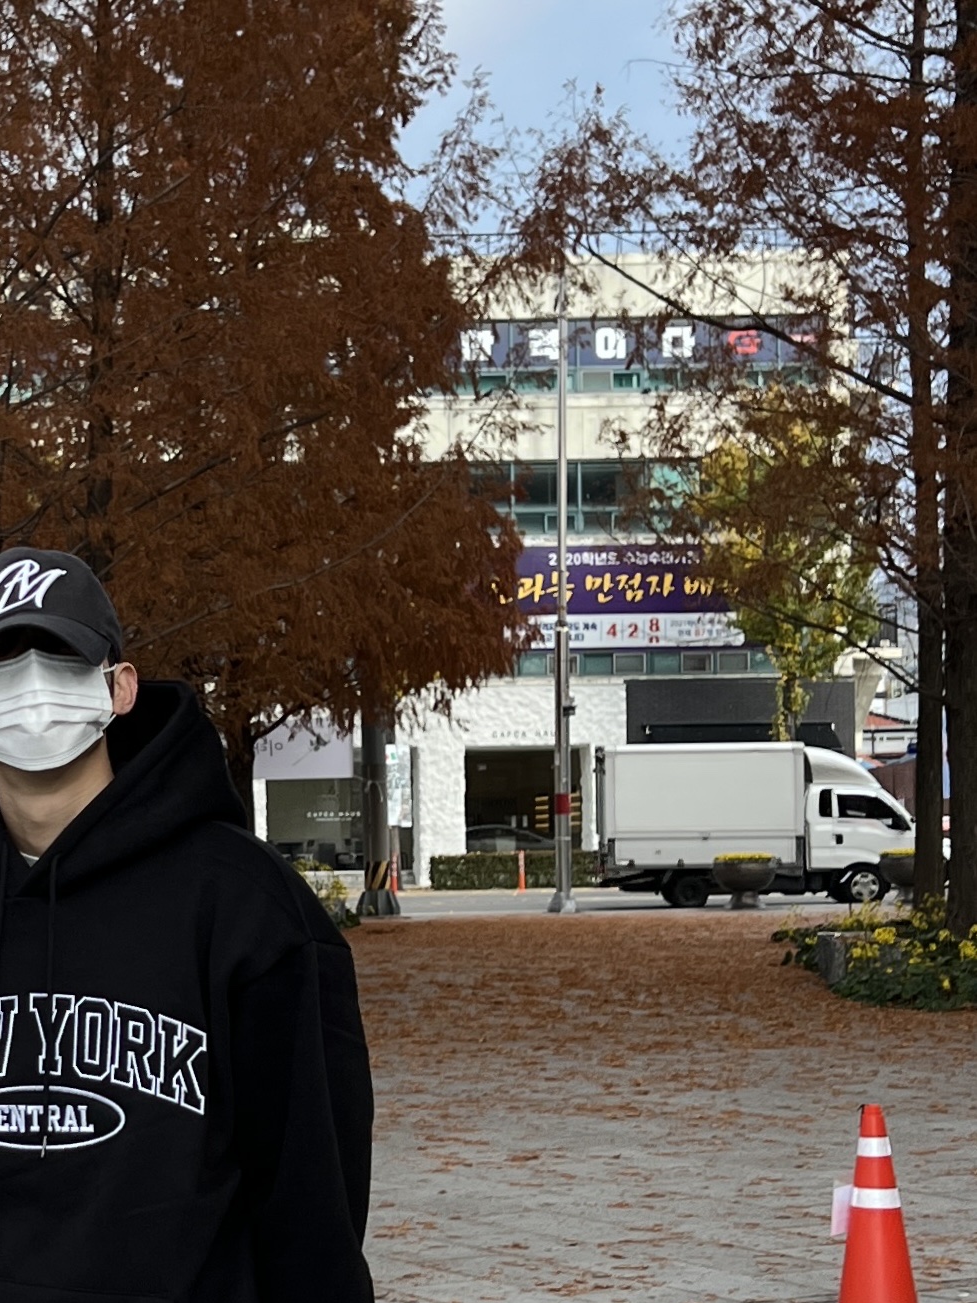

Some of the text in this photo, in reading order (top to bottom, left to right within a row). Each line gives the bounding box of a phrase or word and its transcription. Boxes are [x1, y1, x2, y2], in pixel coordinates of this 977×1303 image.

[547, 552, 620, 566] 220학년도
[584, 572, 675, 604] 만점자
[29, 992, 207, 1115] YORK
